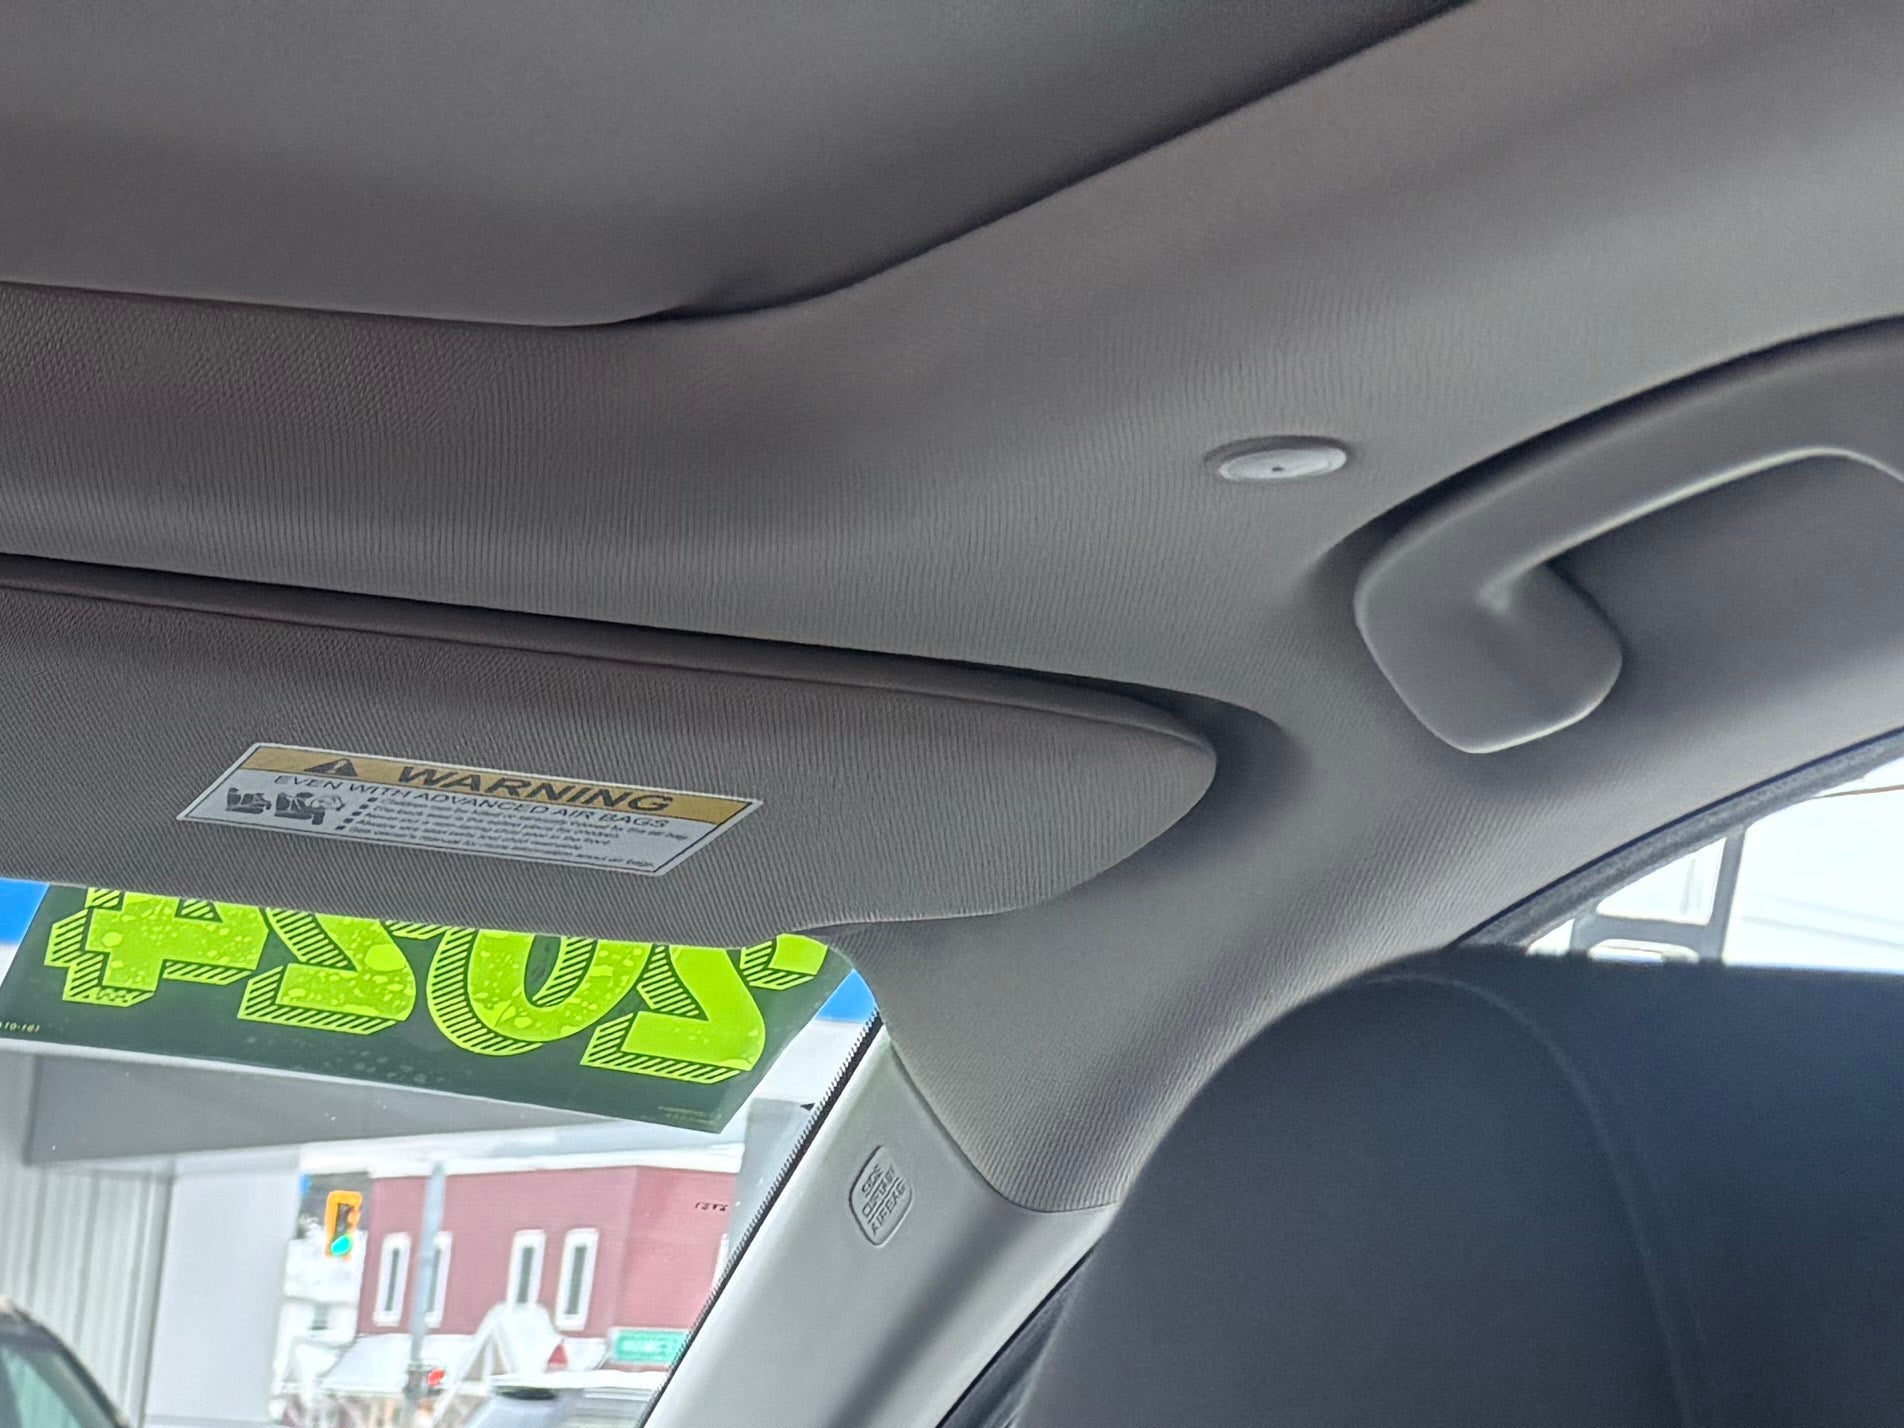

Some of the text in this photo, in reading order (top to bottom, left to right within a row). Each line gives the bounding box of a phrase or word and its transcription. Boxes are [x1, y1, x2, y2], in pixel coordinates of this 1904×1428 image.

[275, 775, 344, 790] EVEN
[349, 782, 408, 799] WITH
[414, 791, 548, 815] ADVANCED
[557, 806, 595, 820] AIR
[599, 813, 670, 829] BAGS
[398, 765, 674, 812] WARNING
